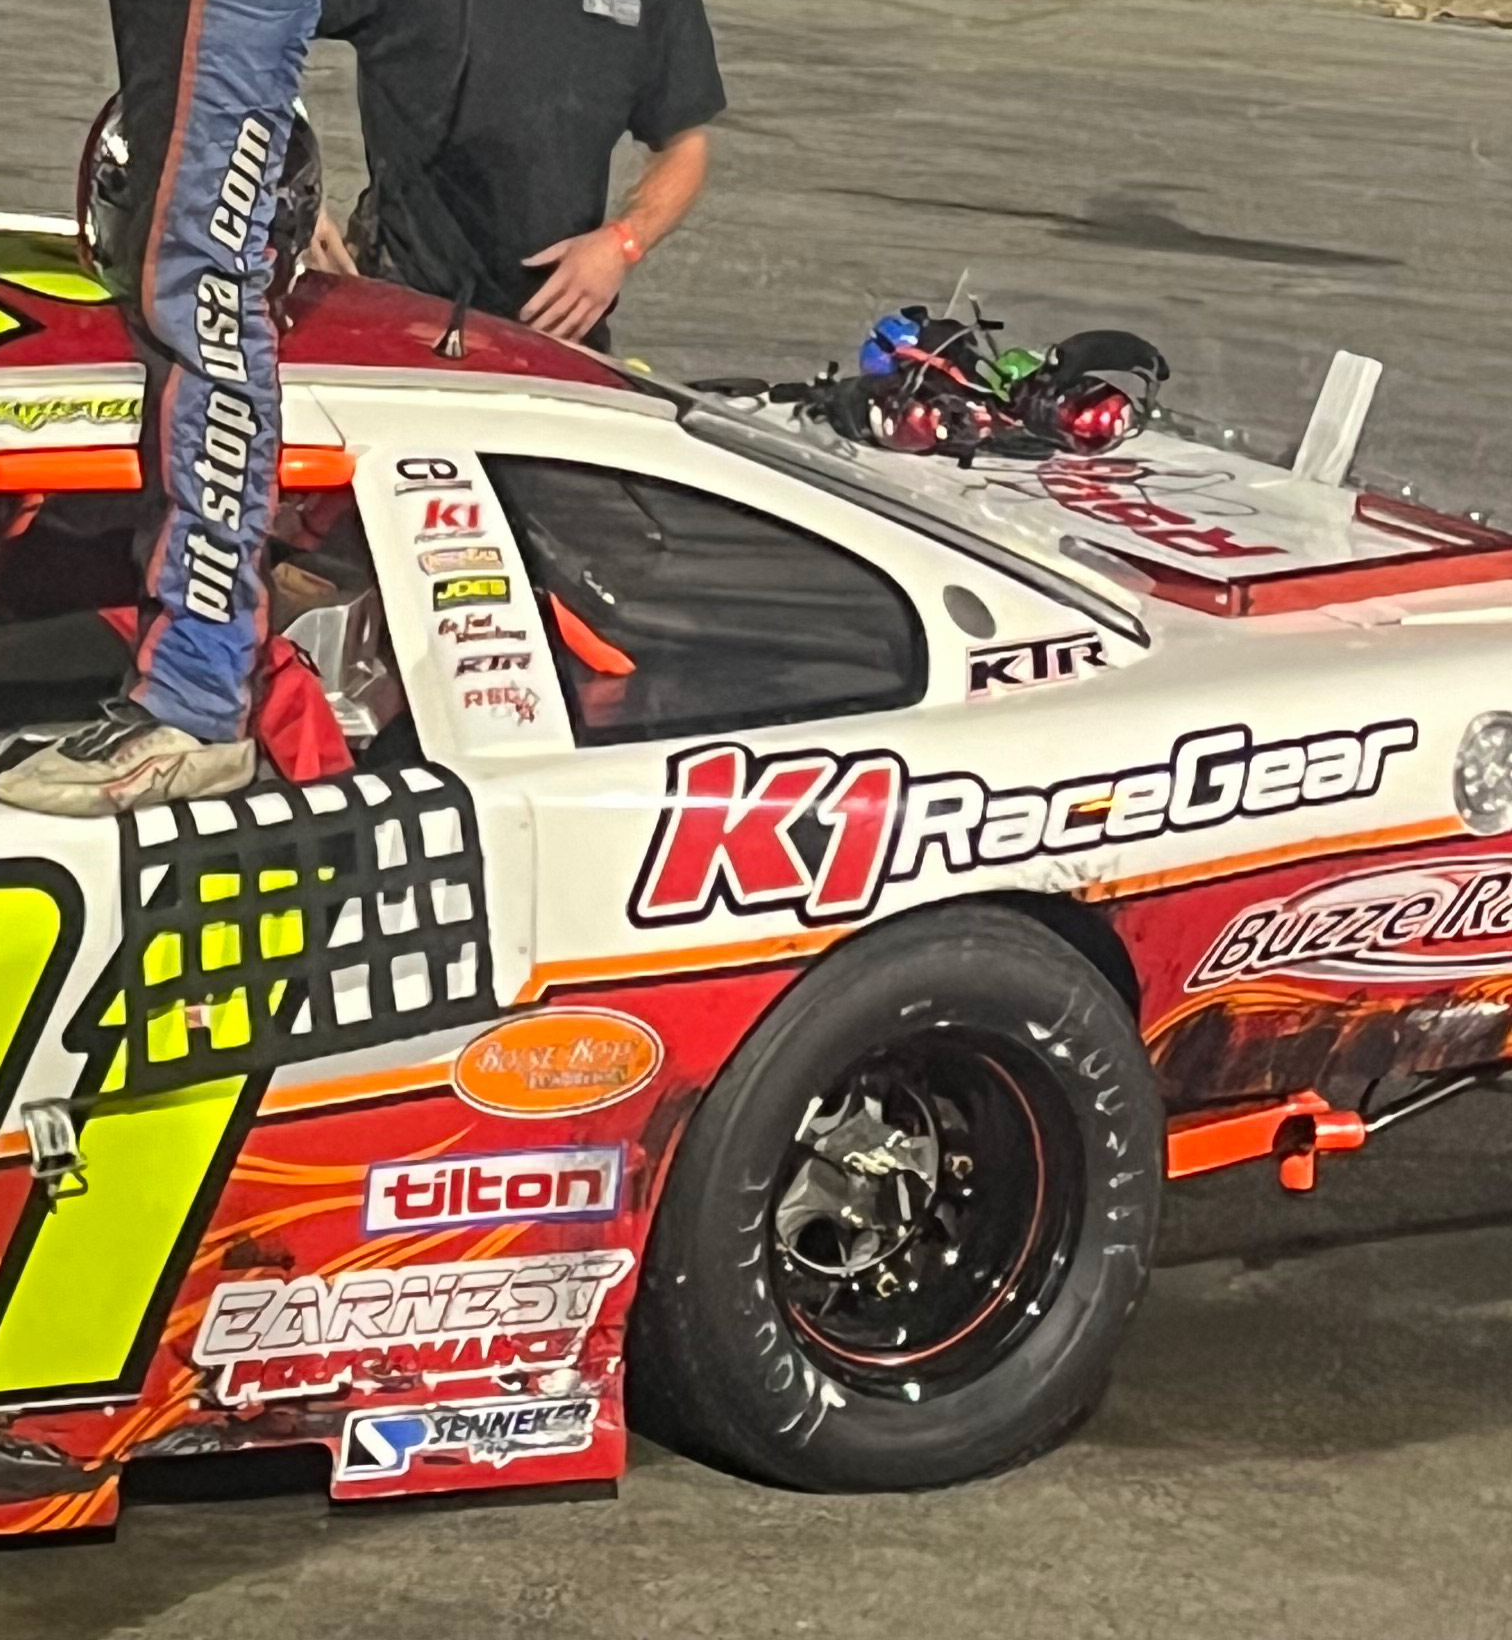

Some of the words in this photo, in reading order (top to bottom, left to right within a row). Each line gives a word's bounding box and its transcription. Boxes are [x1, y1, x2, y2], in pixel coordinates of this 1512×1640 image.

[969, 631, 1107, 692] KTR
[630, 743, 906, 926] K1
[889, 721, 1417, 881] RaceGear
[383, 1165, 604, 1221] tilton
[203, 1260, 625, 1356] EARNEST
